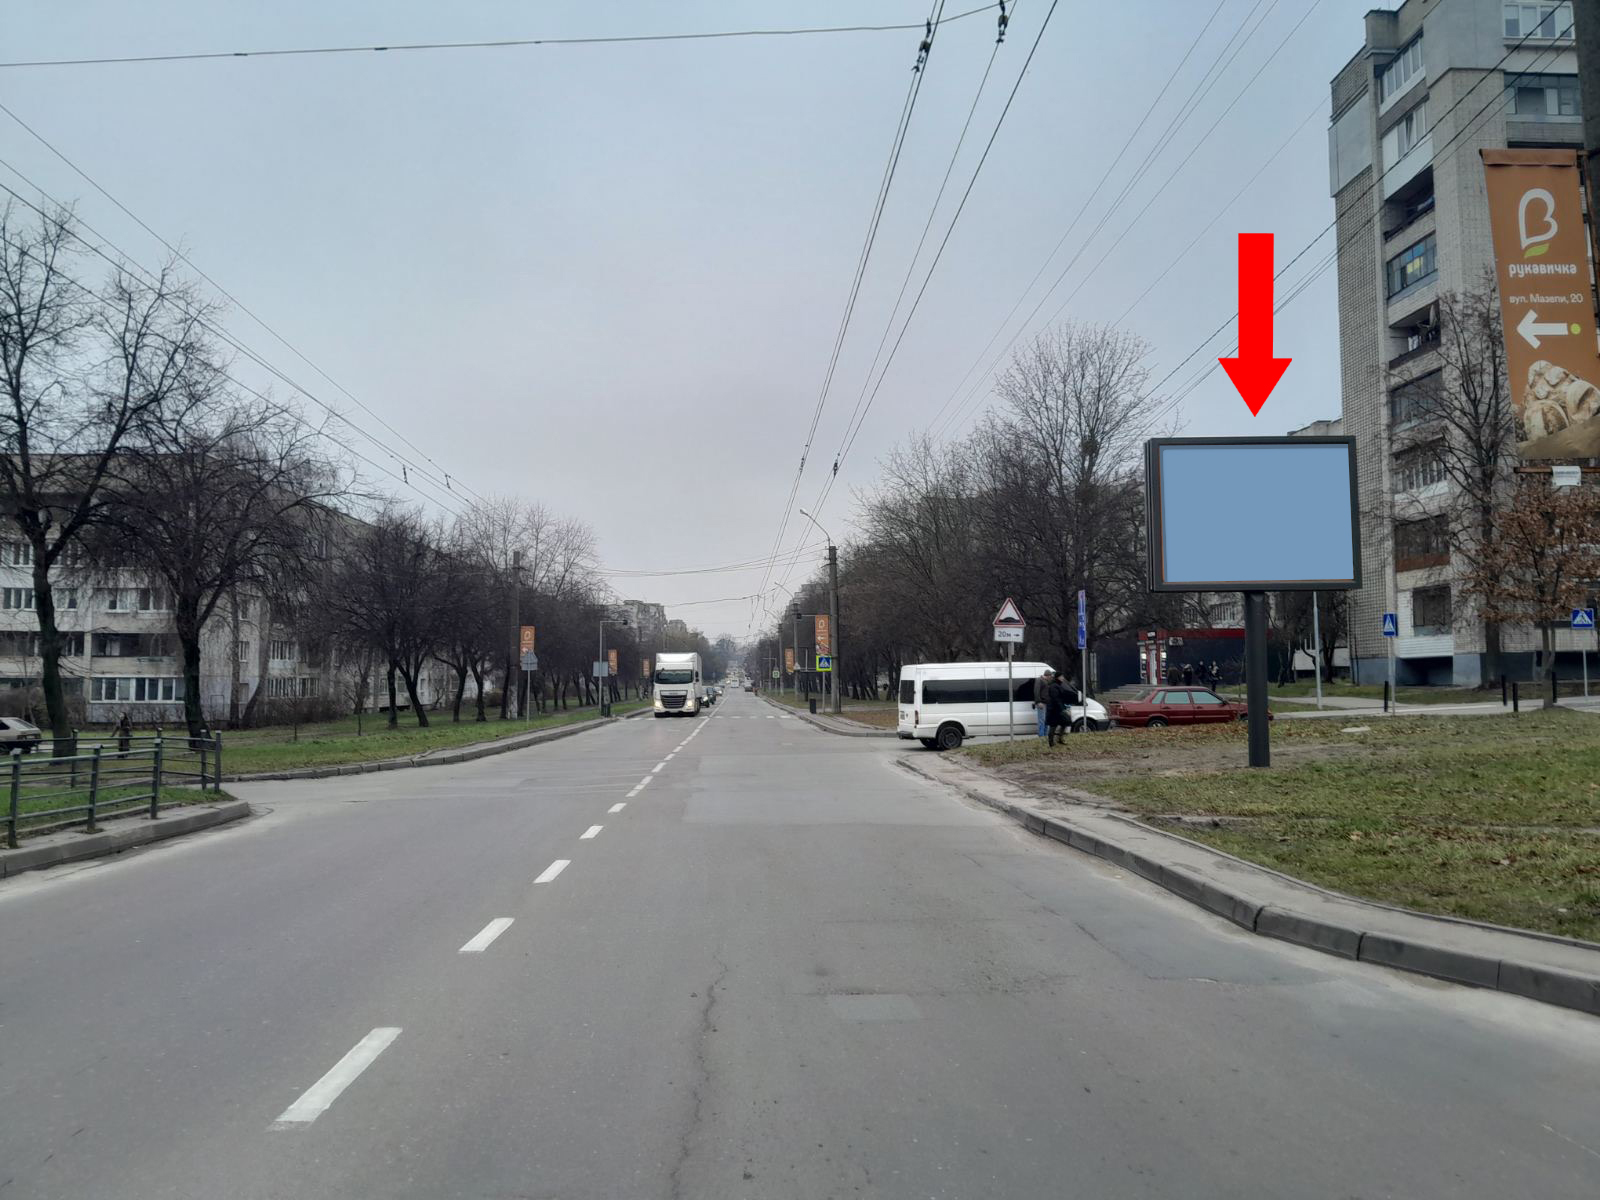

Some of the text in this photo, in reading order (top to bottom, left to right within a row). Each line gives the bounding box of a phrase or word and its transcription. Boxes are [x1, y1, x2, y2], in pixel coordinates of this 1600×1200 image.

[1508, 263, 1577, 278] рукавичка
[1509, 293, 1584, 304] вул. Мазепи, 20
